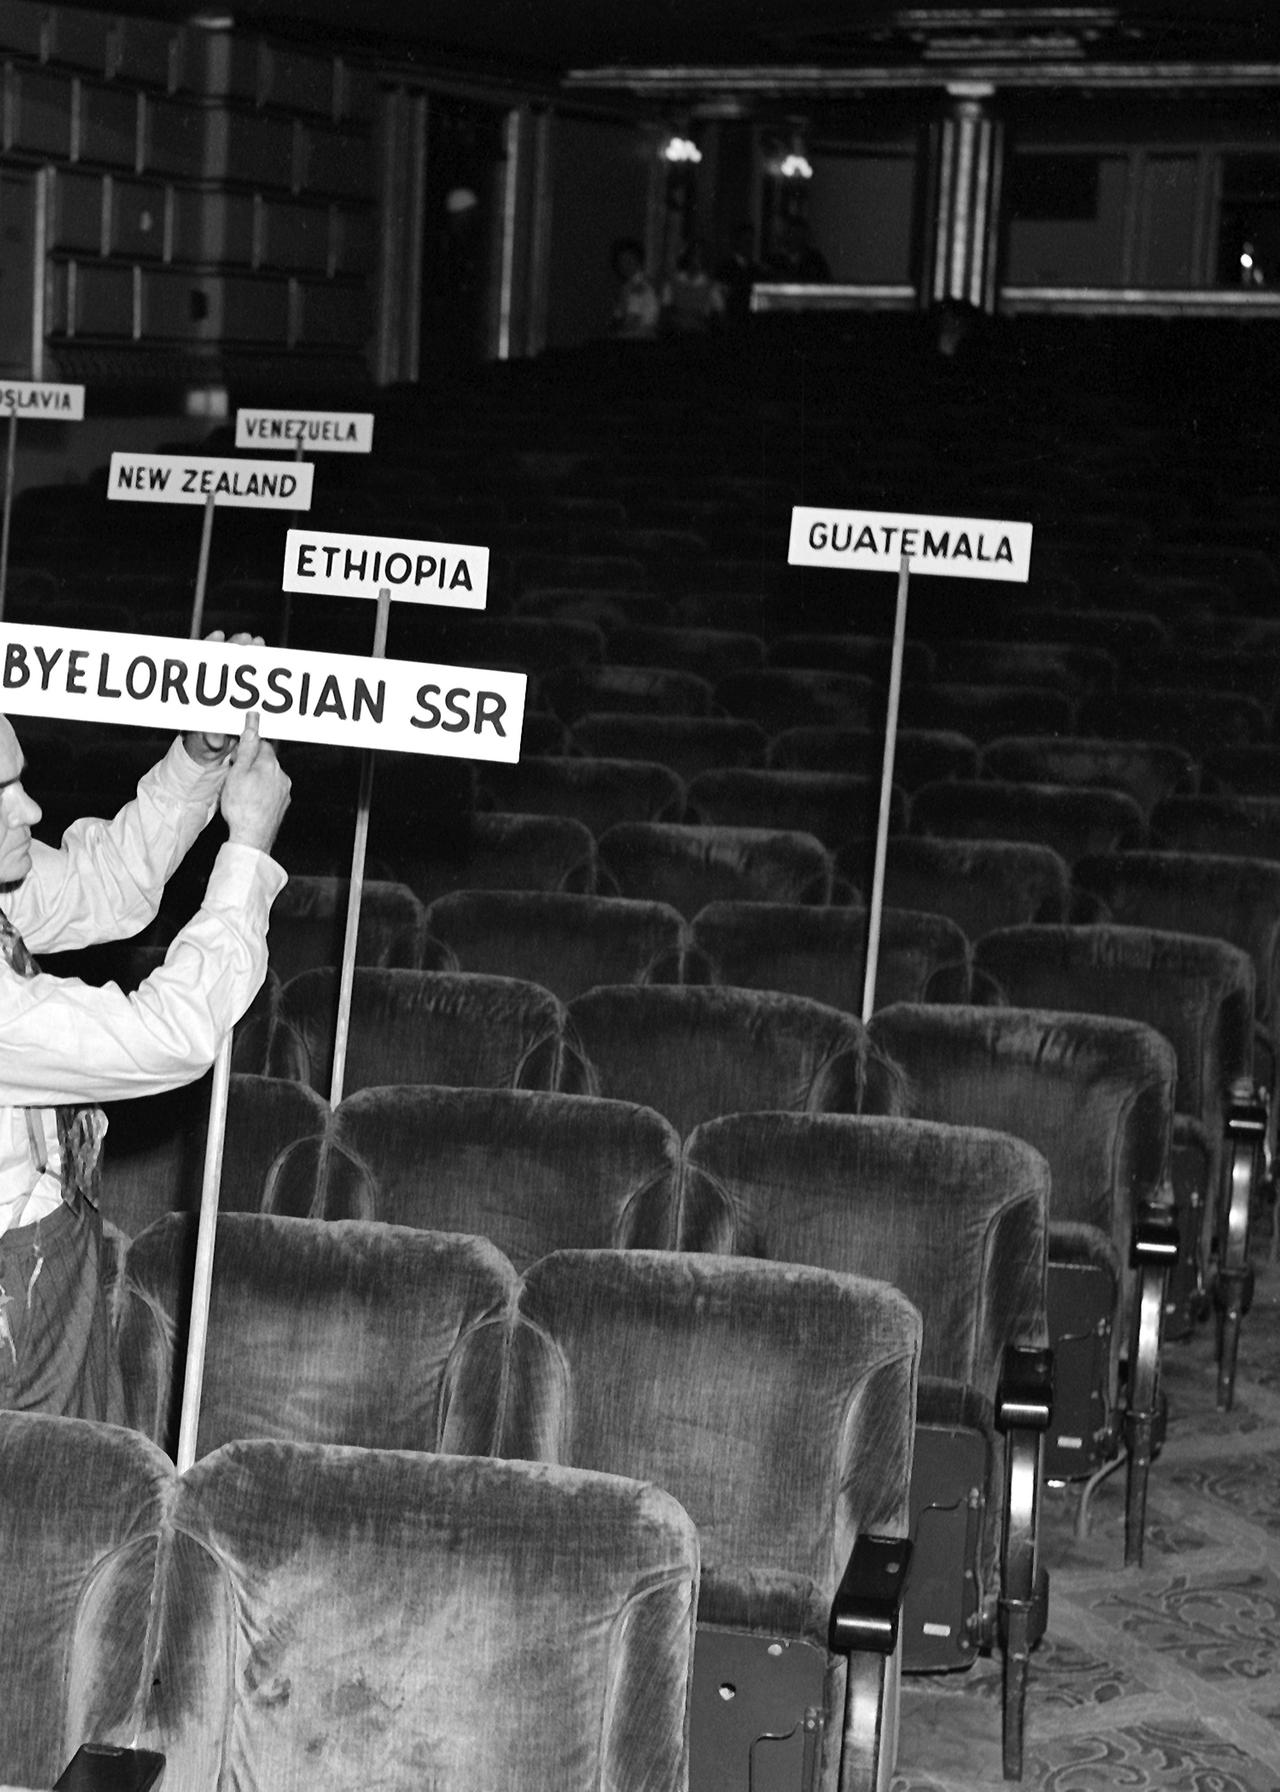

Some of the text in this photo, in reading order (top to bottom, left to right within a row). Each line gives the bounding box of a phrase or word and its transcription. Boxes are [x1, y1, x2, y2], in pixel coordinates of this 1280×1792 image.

[246, 418, 357, 441] VENEZUELA
[118, 466, 298, 498] NEW ZEALAND
[808, 522, 1014, 563] GUATEMALA
[296, 544, 473, 592] ETHIOPIA
[2, 643, 507, 738] BYELORUSSIAN SSR
